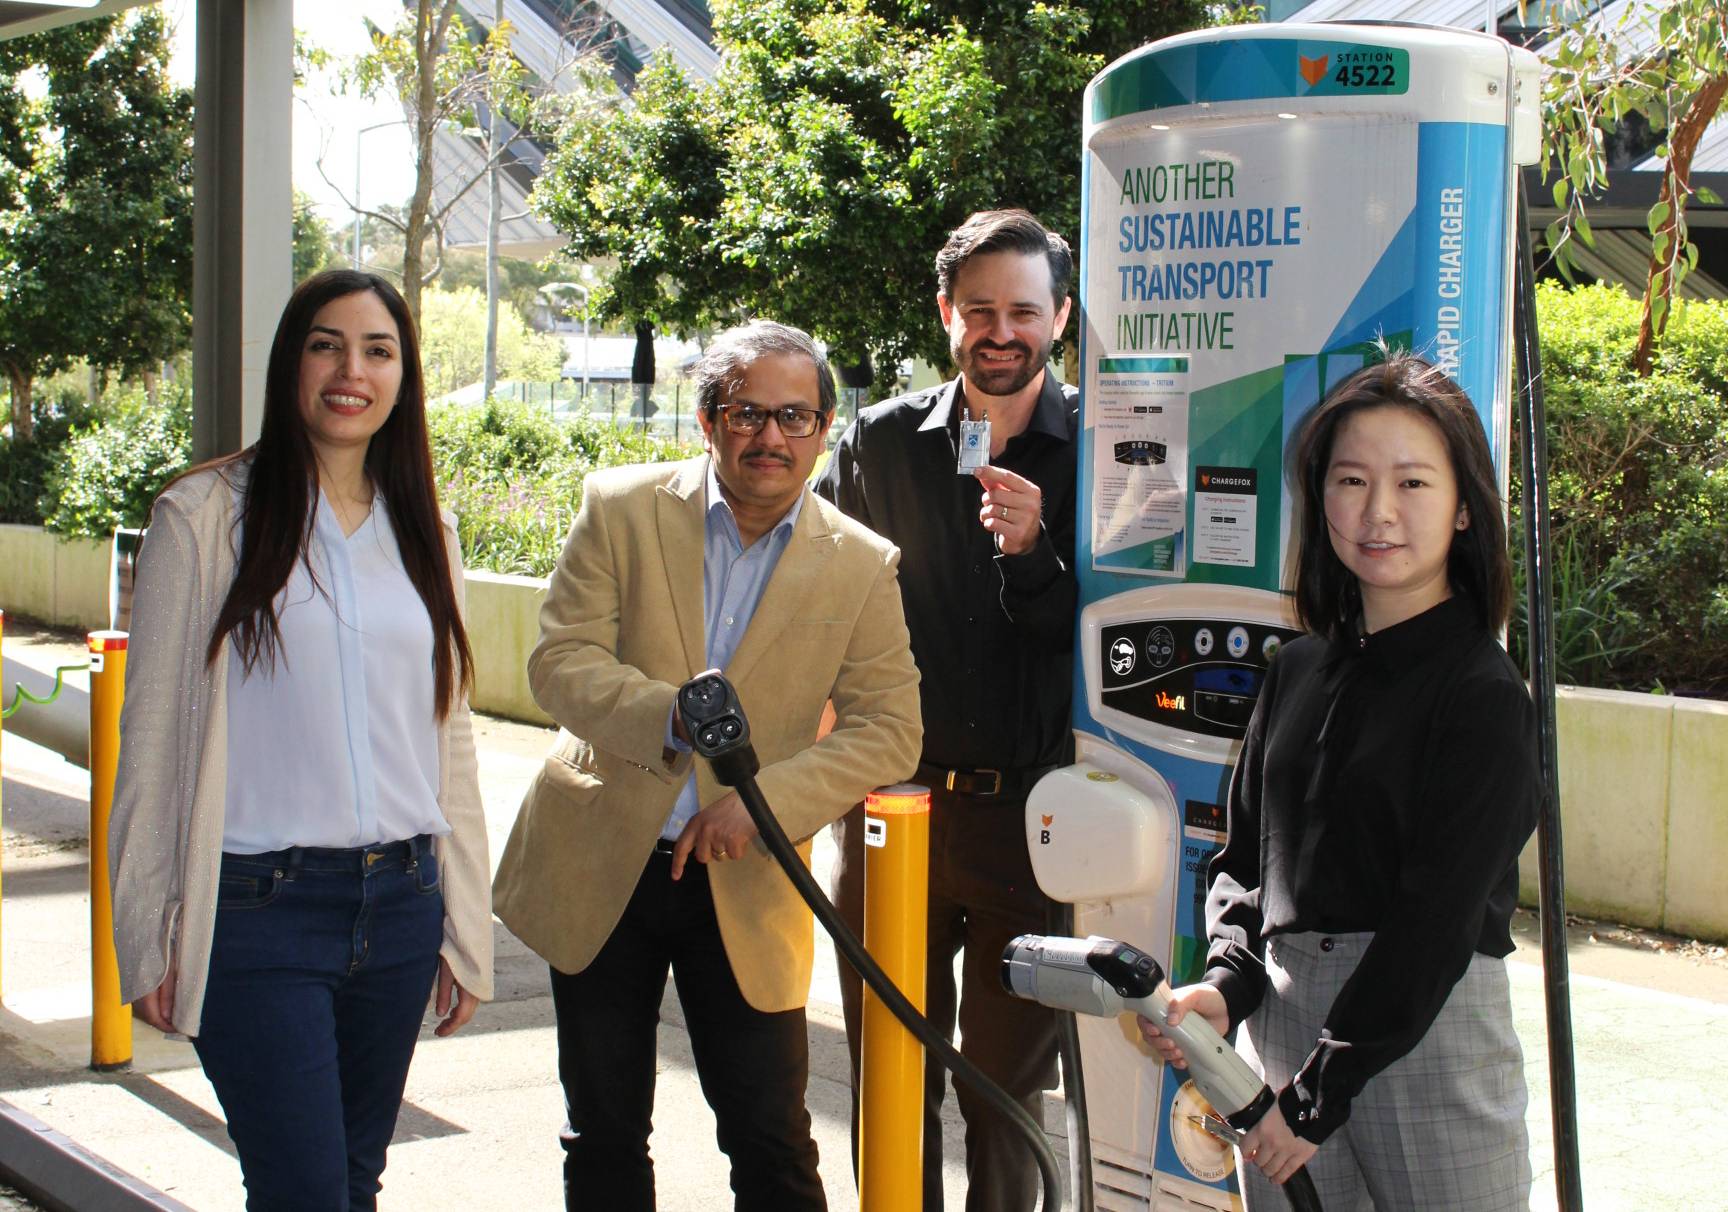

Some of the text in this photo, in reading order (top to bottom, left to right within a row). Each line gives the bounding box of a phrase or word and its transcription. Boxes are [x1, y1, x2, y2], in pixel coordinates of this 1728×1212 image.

[1337, 53, 1393, 63] STATION
[1335, 64, 1395, 87] 4522
[1120, 161, 1234, 205] ANOTHER
[1118, 206, 1301, 254] SUSTAINABLE
[1438, 187, 1463, 299] CHARGER
[1118, 259, 1274, 302] TRANSPORT
[1117, 311, 1235, 352] INITIATIVE
[1211, 477, 1251, 486] CHARGEFOX
[1040, 829, 1050, 844] B
[1185, 846, 1199, 858] FOR
[1202, 1168, 1224, 1178] RELEASE
